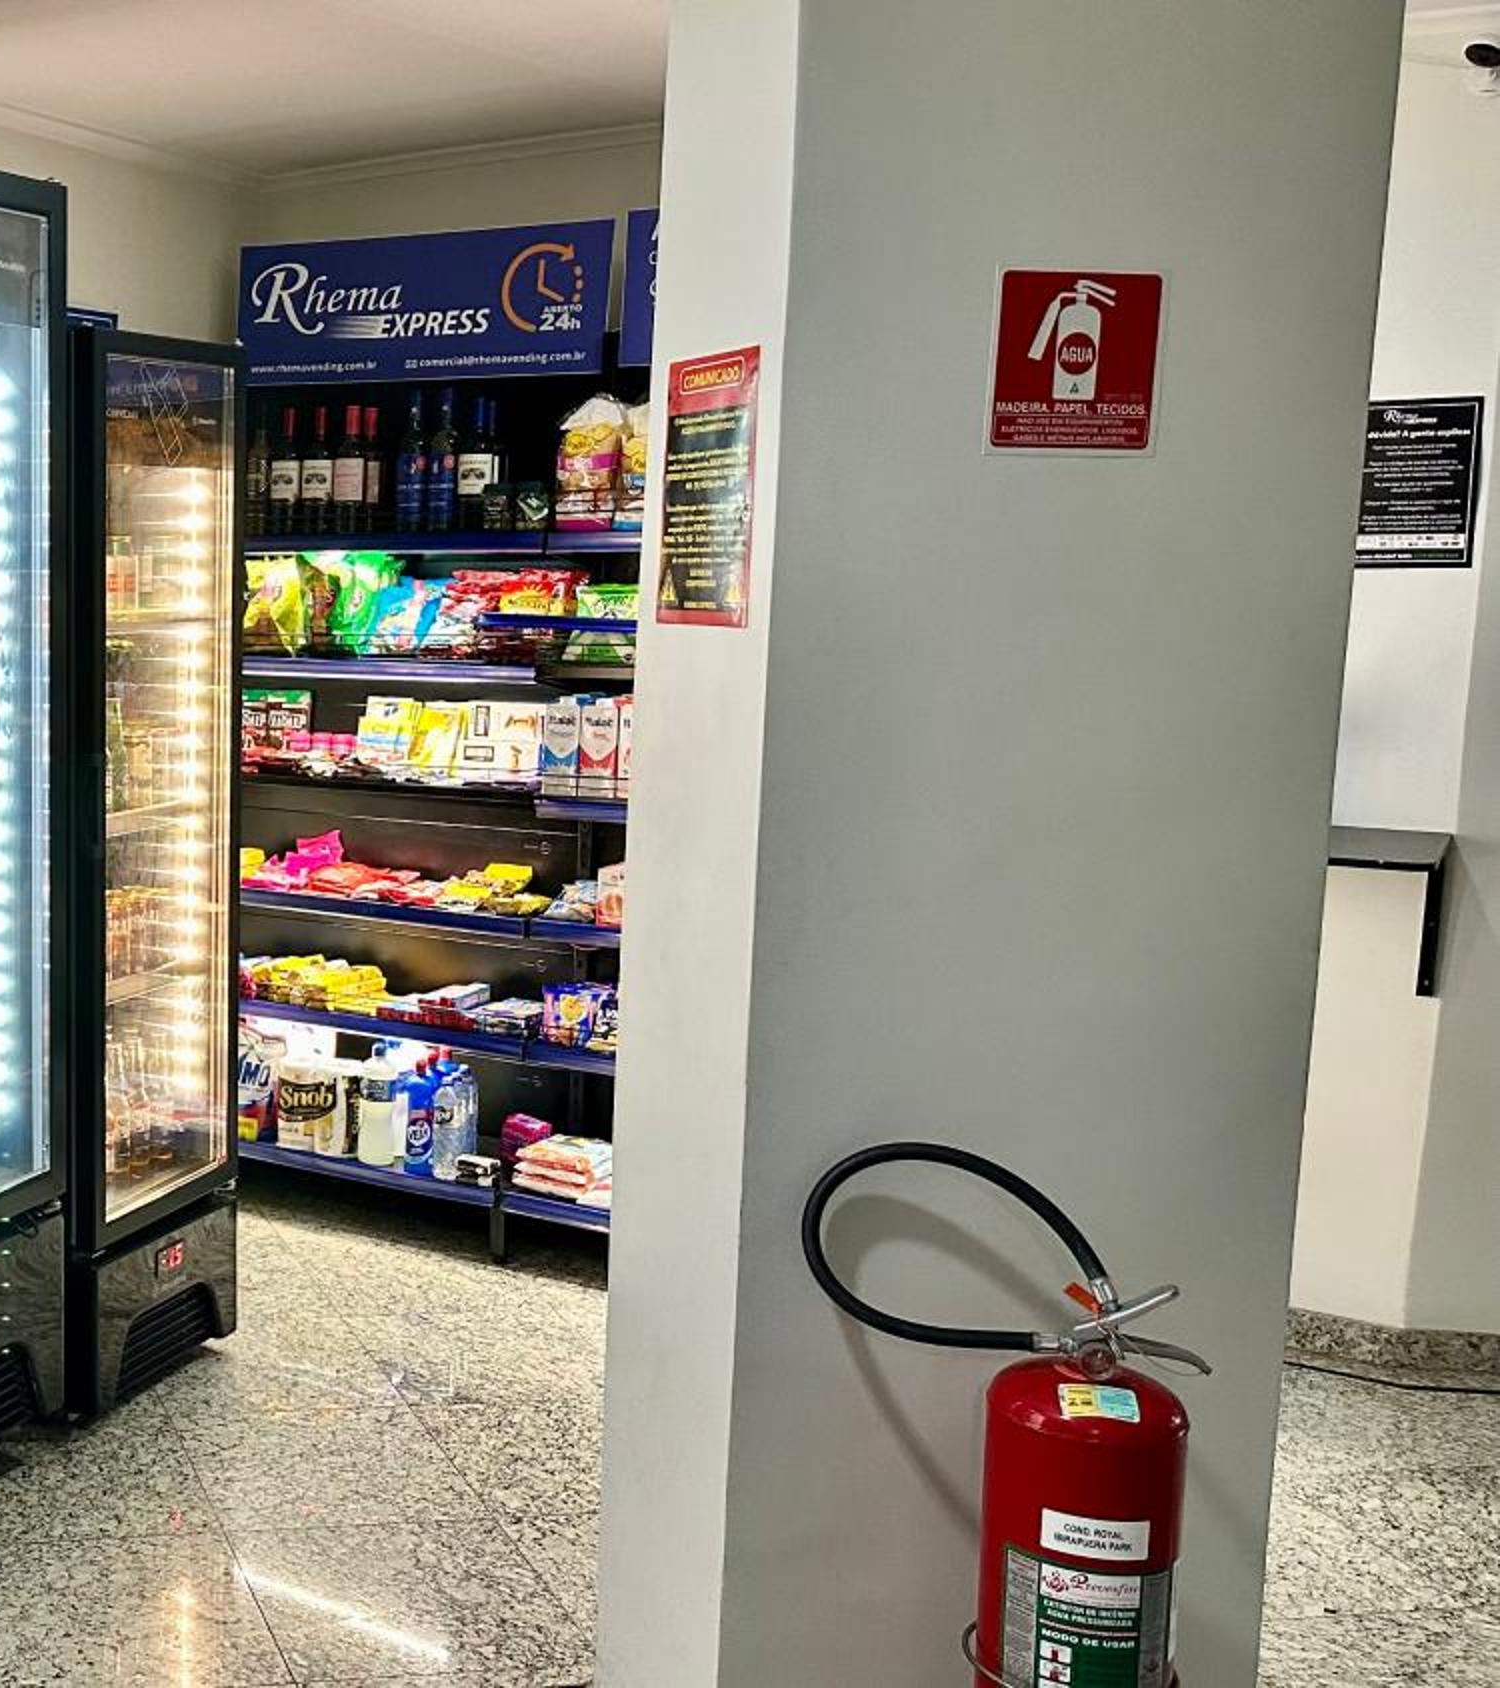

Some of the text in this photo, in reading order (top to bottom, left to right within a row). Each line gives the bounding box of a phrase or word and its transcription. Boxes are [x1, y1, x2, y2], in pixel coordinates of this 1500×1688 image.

[251, 263, 402, 336] Rhema
[543, 304, 583, 313] ABERTO
[377, 308, 490, 339] EXPRESS
[539, 313, 582, 331] 24h
[683, 366, 741, 389] COMUNICADO
[280, 1084, 334, 1109] Snob
[1063, 1523, 1124, 1541] COND. ROYAL
[1109, 1541, 1133, 1552] PARK
[1041, 1627, 1135, 1650] MODO DE USAR
